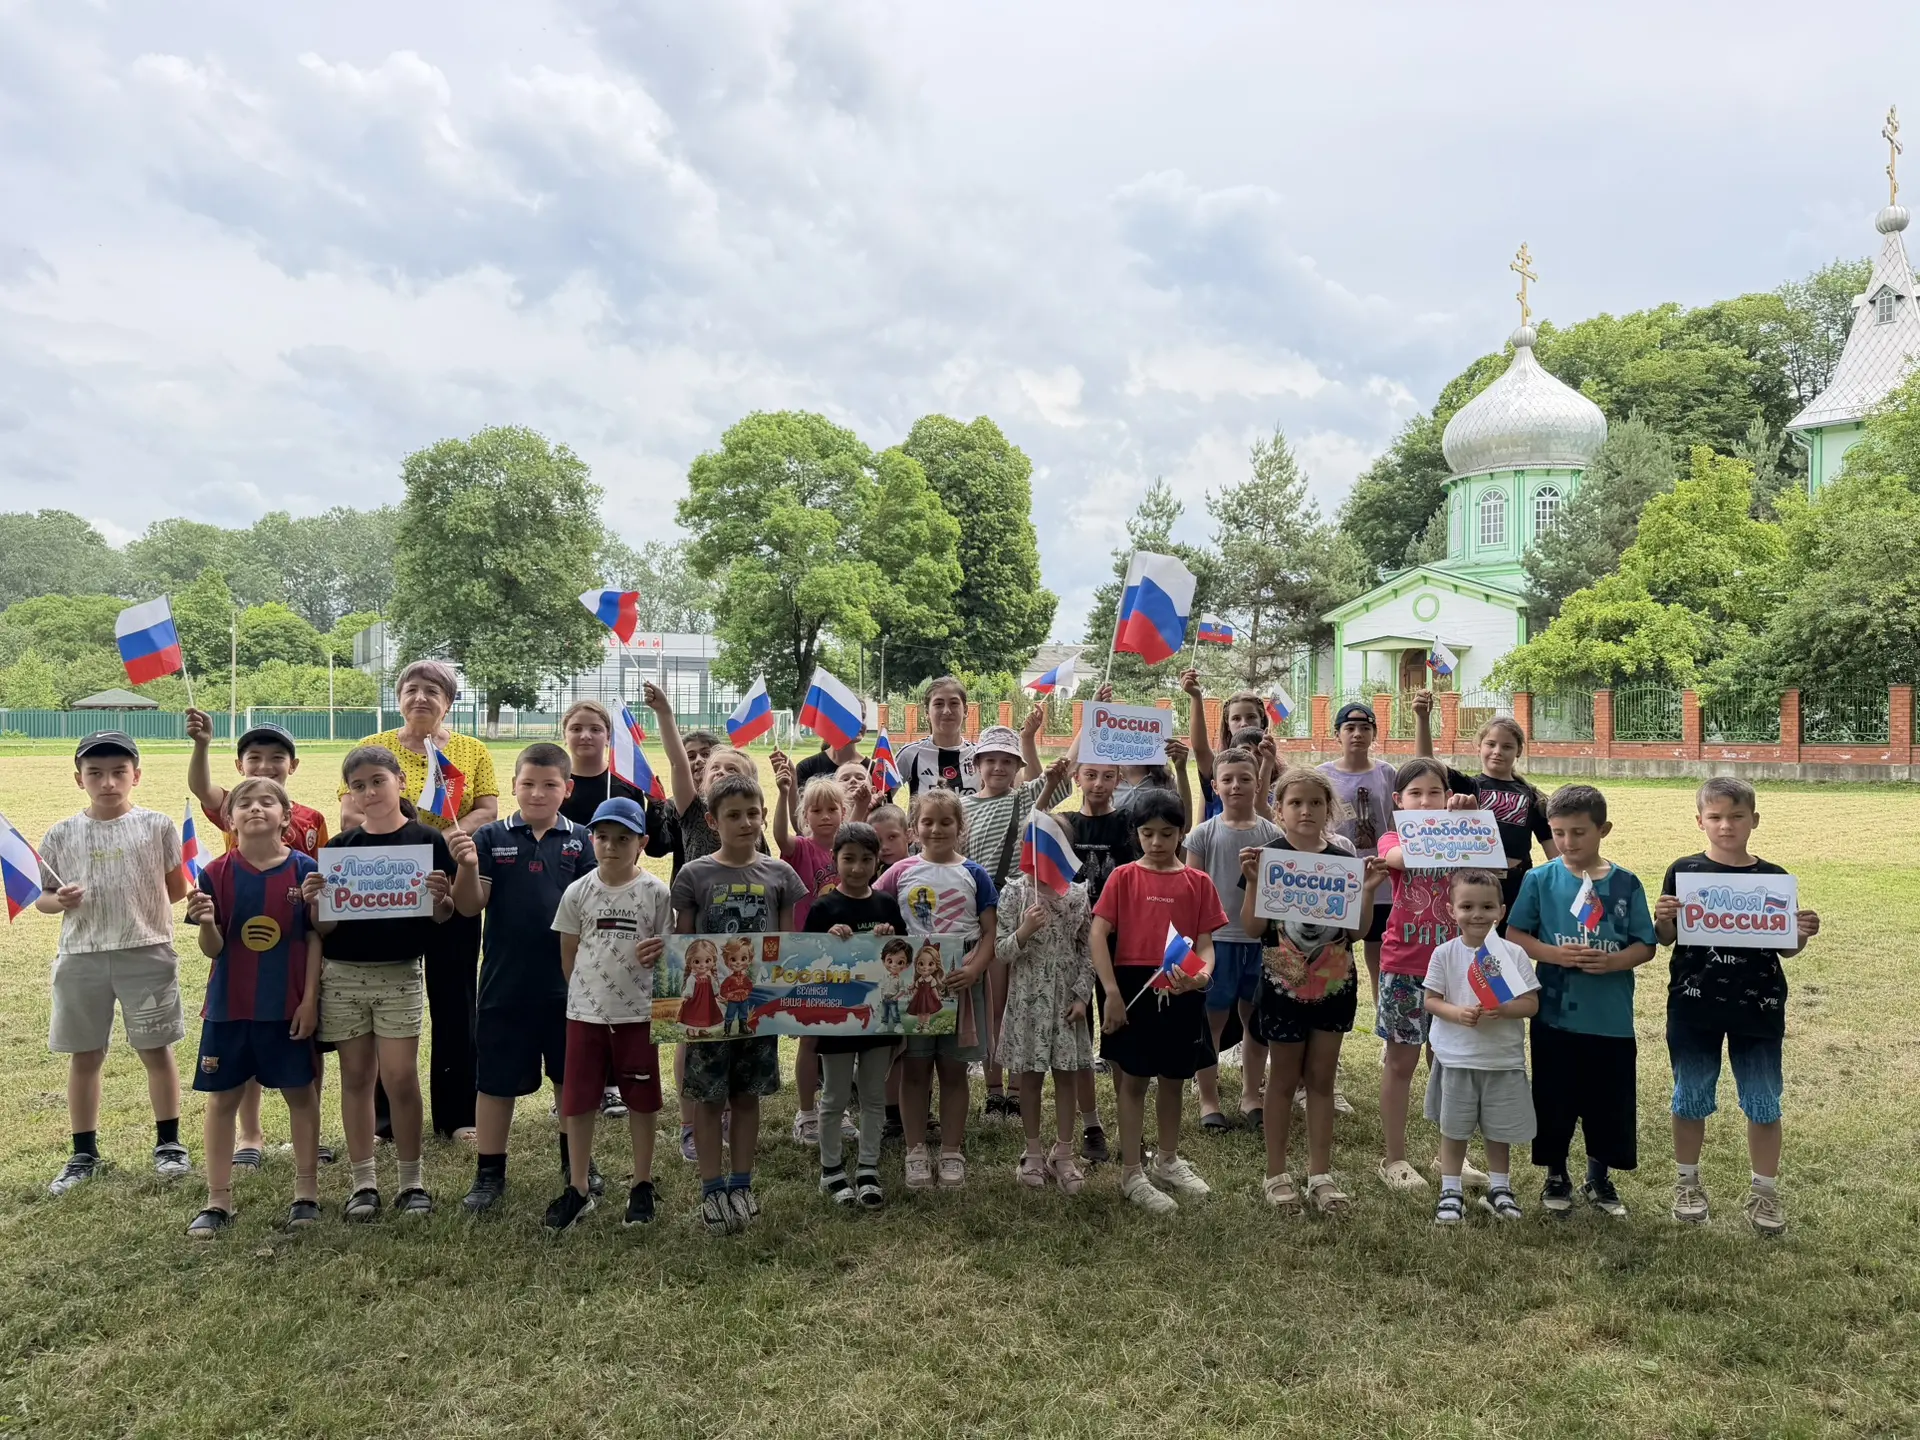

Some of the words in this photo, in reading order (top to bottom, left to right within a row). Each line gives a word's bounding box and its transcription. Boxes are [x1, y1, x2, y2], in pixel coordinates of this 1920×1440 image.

[1095, 709, 1160, 734] Россия
[1100, 727, 1109, 741] в
[1112, 731, 1154, 745] моём
[1096, 741, 1154, 758] сердце
[1401, 823, 1416, 839] С
[1417, 820, 1492, 836] любовью
[1409, 841, 1421, 852] к
[1421, 836, 1490, 859] Родине
[341, 858, 415, 877] Люблю
[357, 874, 411, 891] тебя,
[334, 887, 418, 909] Россия
[1325, 894, 1345, 917] Я
[1707, 888, 1762, 912] Моя
[597, 908, 638, 918] TOMMY
[1685, 903, 1787, 931] Россия
